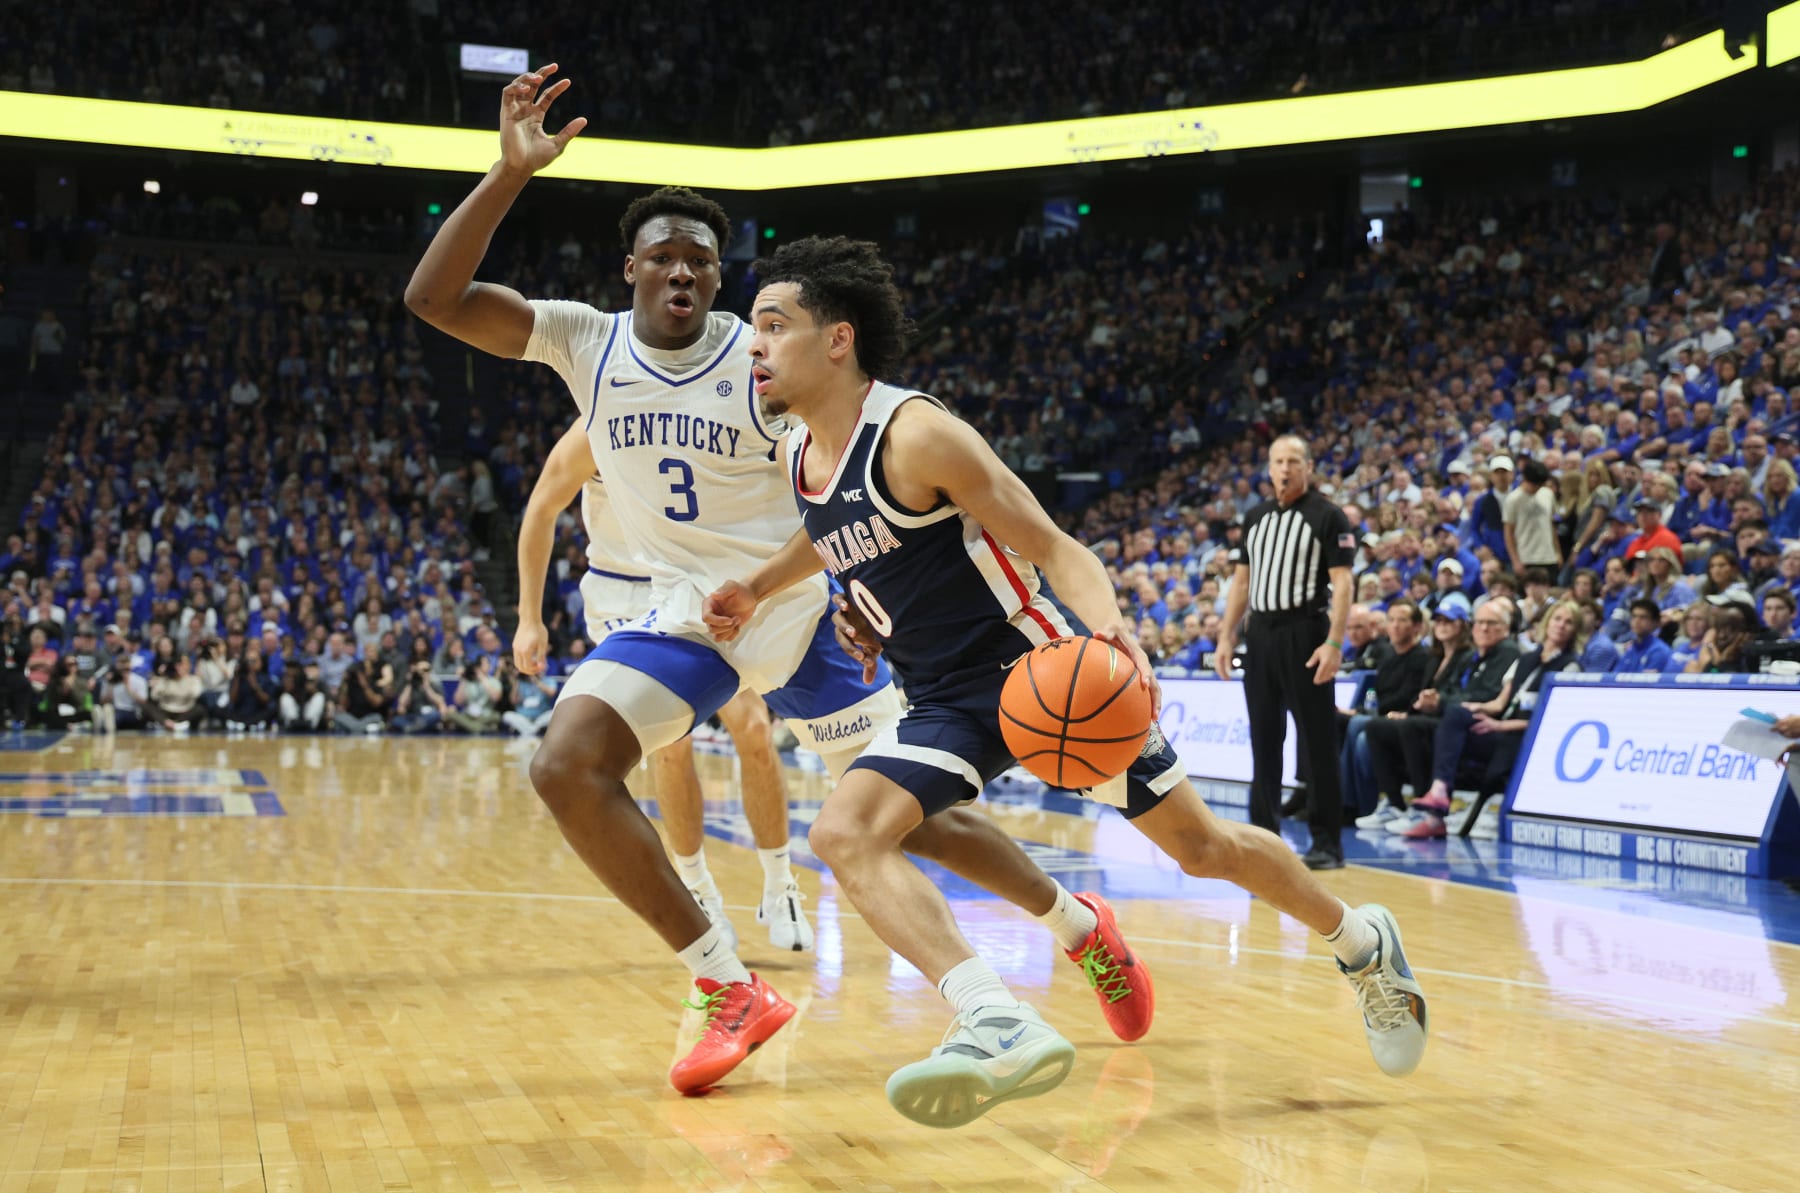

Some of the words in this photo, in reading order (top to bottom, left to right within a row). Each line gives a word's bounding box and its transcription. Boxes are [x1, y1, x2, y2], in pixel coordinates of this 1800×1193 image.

[717, 381, 732, 396] SEC
[608, 413, 740, 458] KENTUCKY
[659, 457, 699, 522] 3
[850, 579, 893, 638] 0
[808, 715, 872, 742] Wildcats
[1555, 720, 1610, 783] C
[1614, 739, 1697, 775] Central
[1697, 744, 1760, 781] Bank
